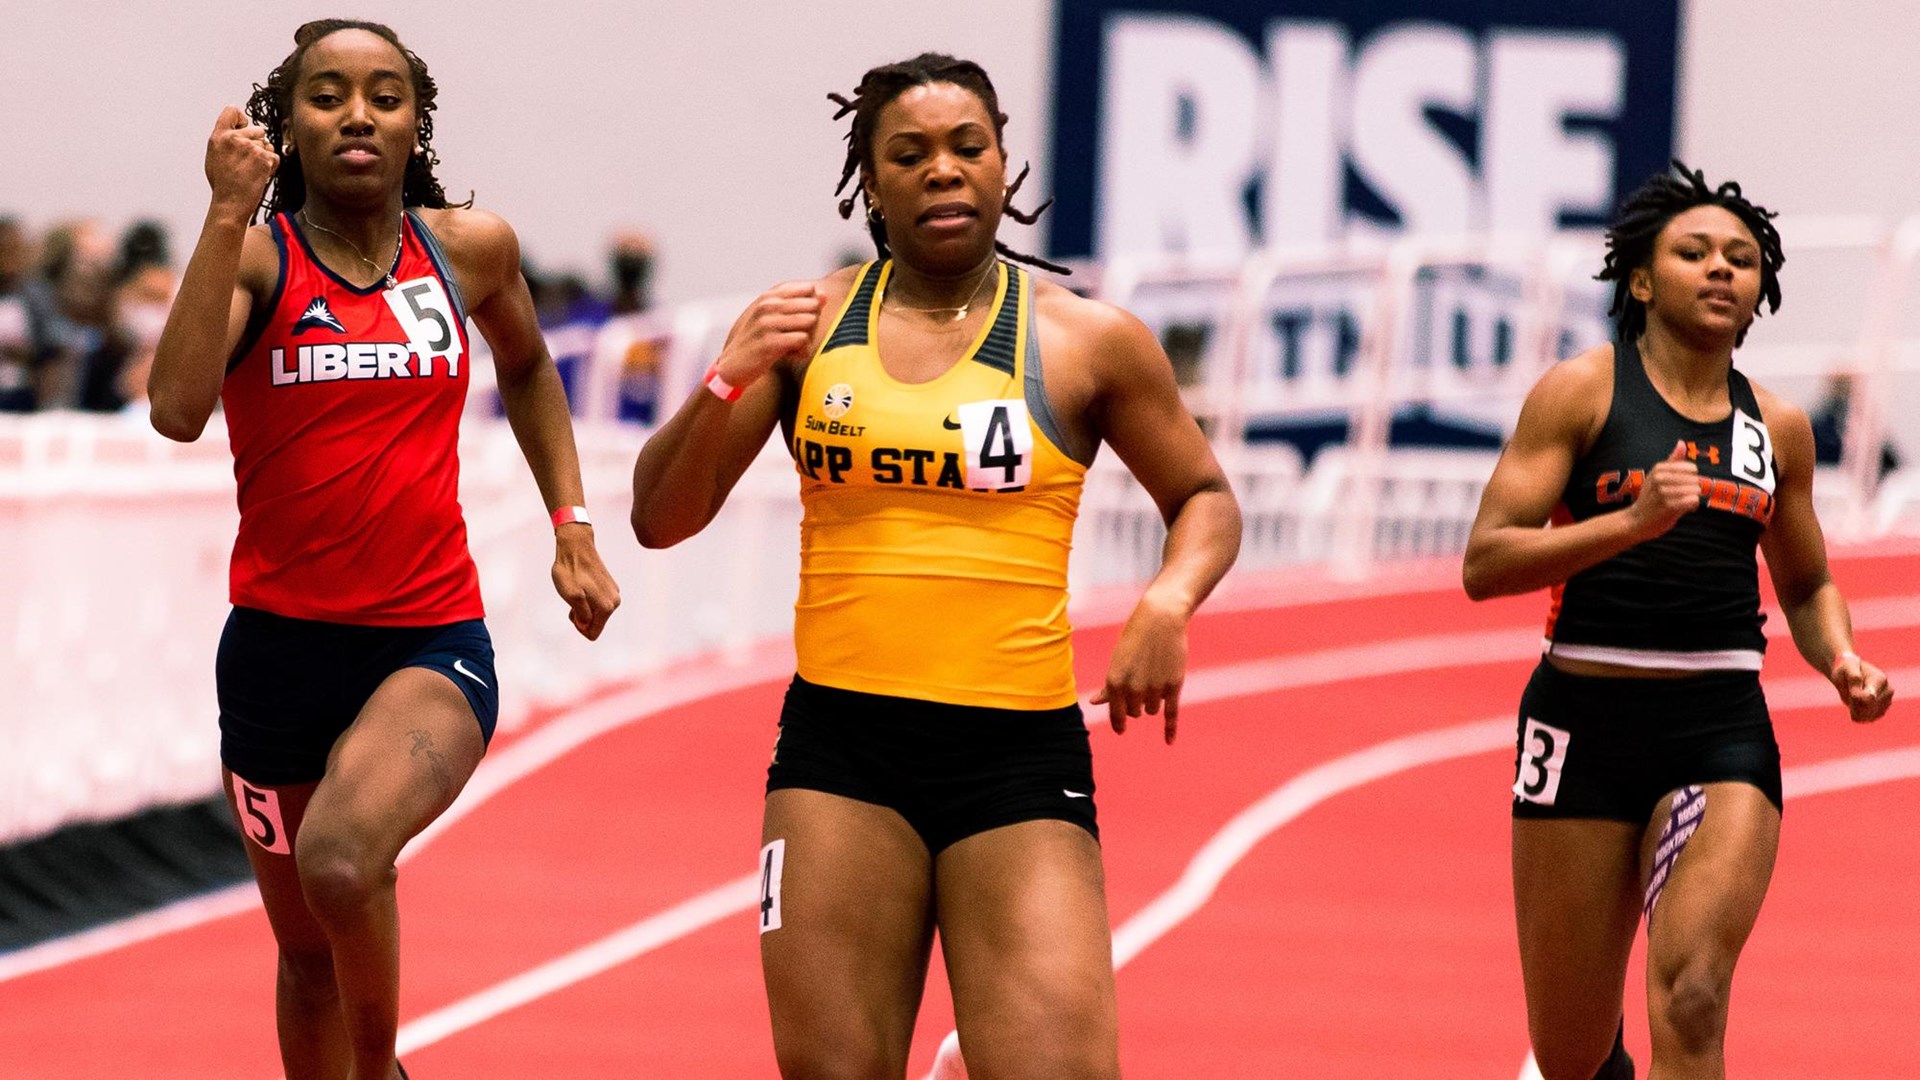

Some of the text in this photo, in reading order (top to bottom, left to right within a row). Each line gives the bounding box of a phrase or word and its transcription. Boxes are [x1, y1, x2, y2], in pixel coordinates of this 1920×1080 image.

[1100, 16, 1626, 266] RISE
[401, 282, 452, 352] 5
[871, 448, 1025, 494] STA
[979, 406, 1022, 483] 4
[1743, 421, 1766, 480] 3
[1523, 728, 1555, 797] 3
[243, 784, 276, 847] 5
[760, 849, 773, 927] 4
